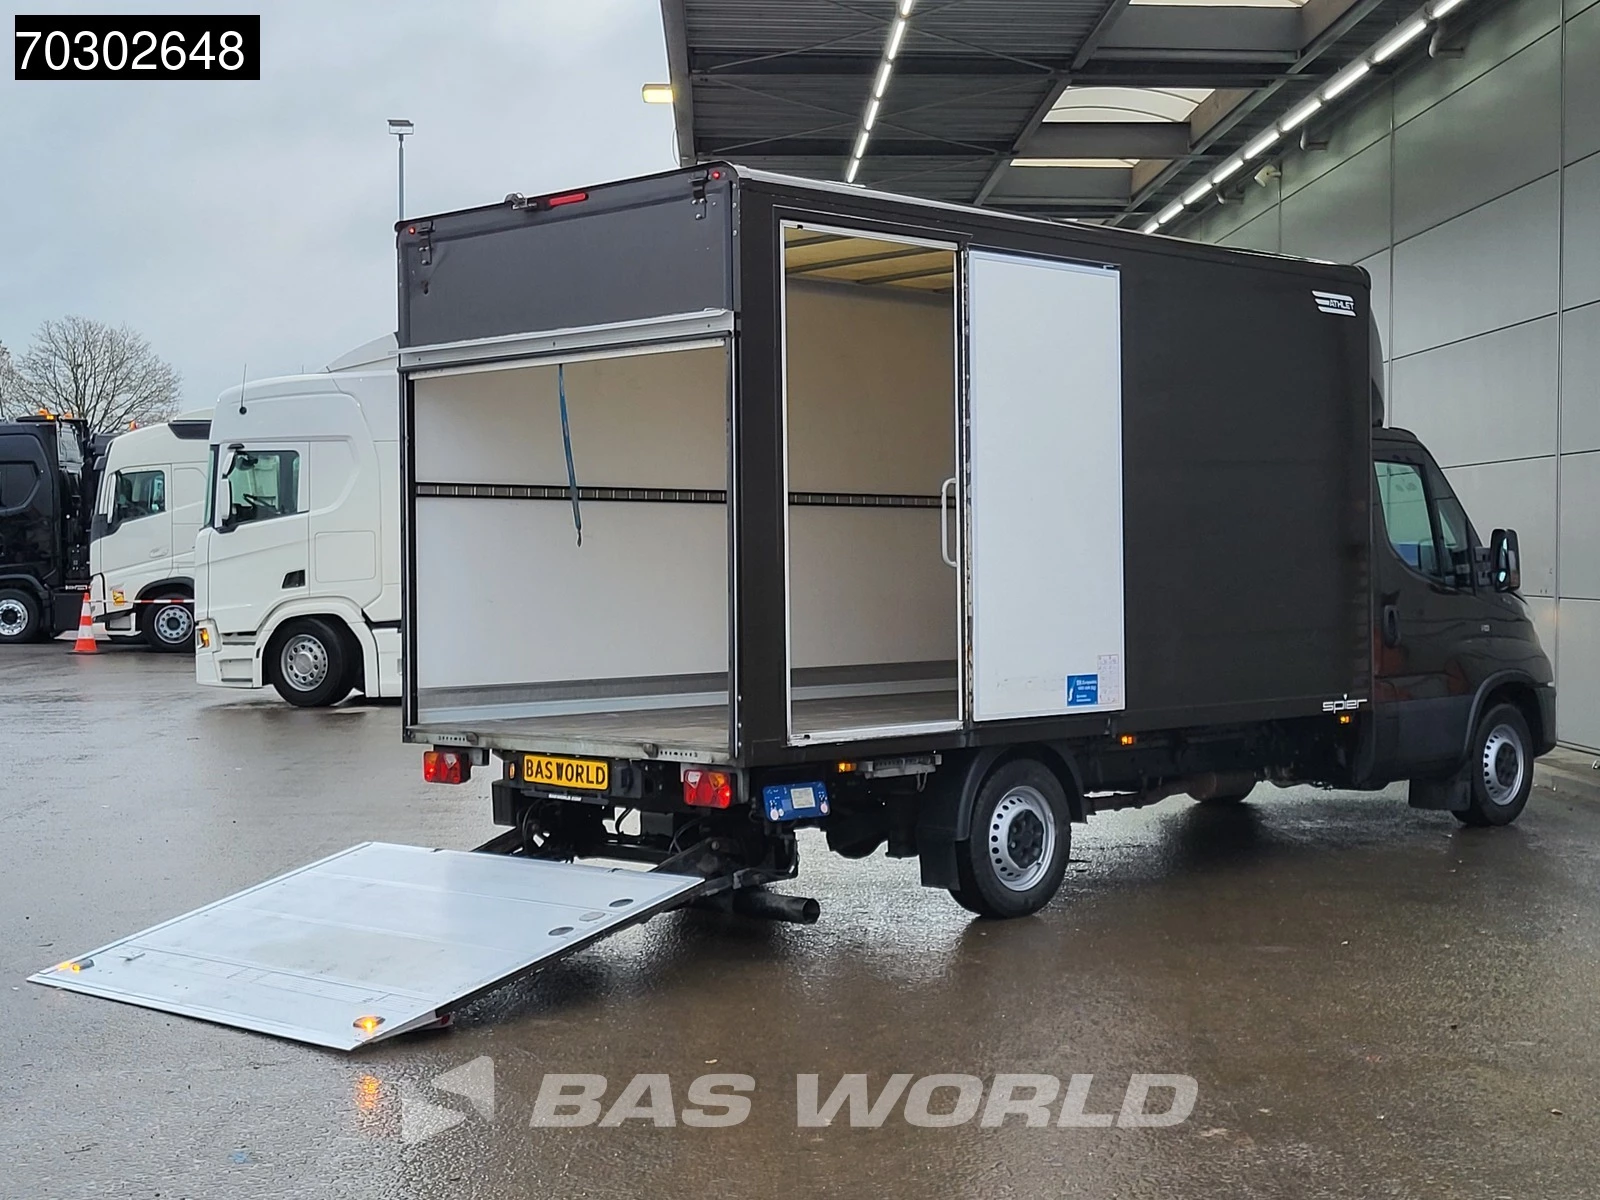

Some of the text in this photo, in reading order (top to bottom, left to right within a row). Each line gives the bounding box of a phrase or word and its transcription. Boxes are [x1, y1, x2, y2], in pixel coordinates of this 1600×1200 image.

[1329, 299, 1354, 311] ATHLET
[1322, 693, 1368, 714] spier
[526, 759, 606, 785] BAS WORLD
